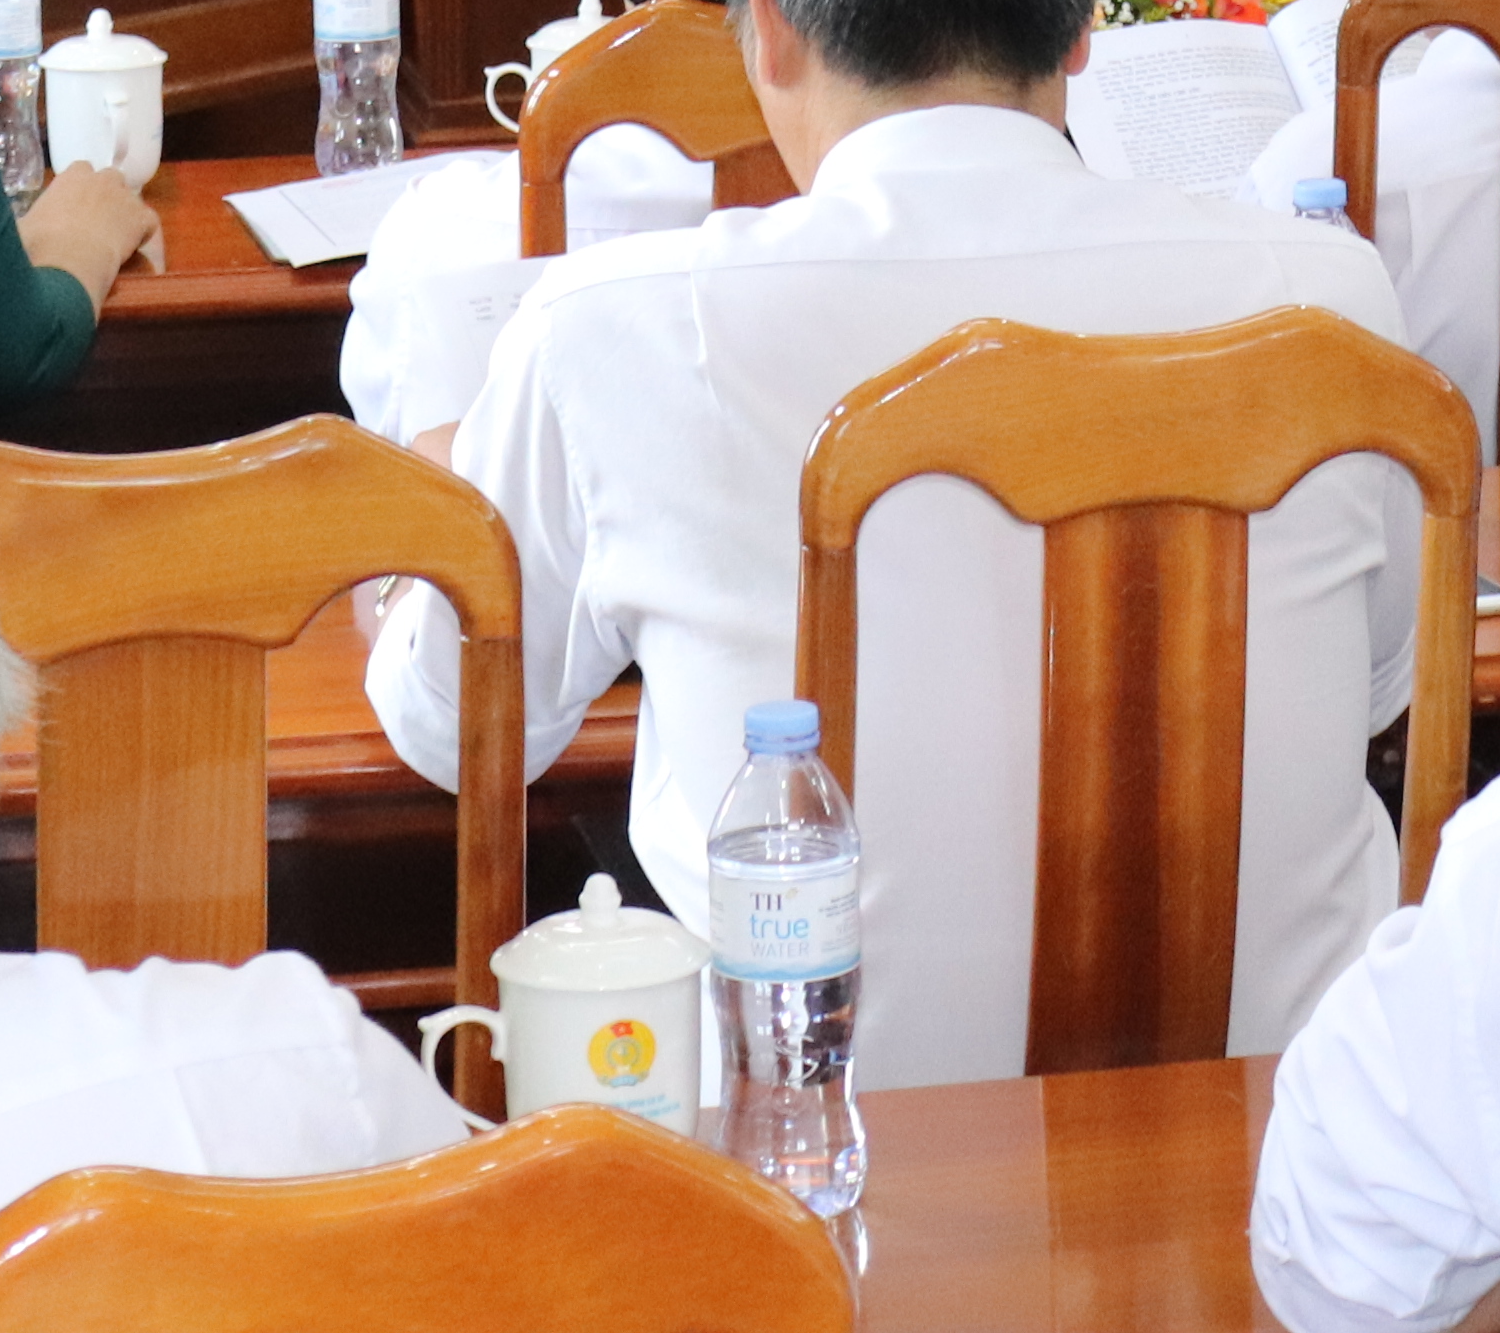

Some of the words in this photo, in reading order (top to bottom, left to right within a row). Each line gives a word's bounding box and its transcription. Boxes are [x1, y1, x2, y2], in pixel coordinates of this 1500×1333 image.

[750, 892, 783, 911] TH
[751, 914, 809, 940] true
[751, 941, 810, 958] WATER
